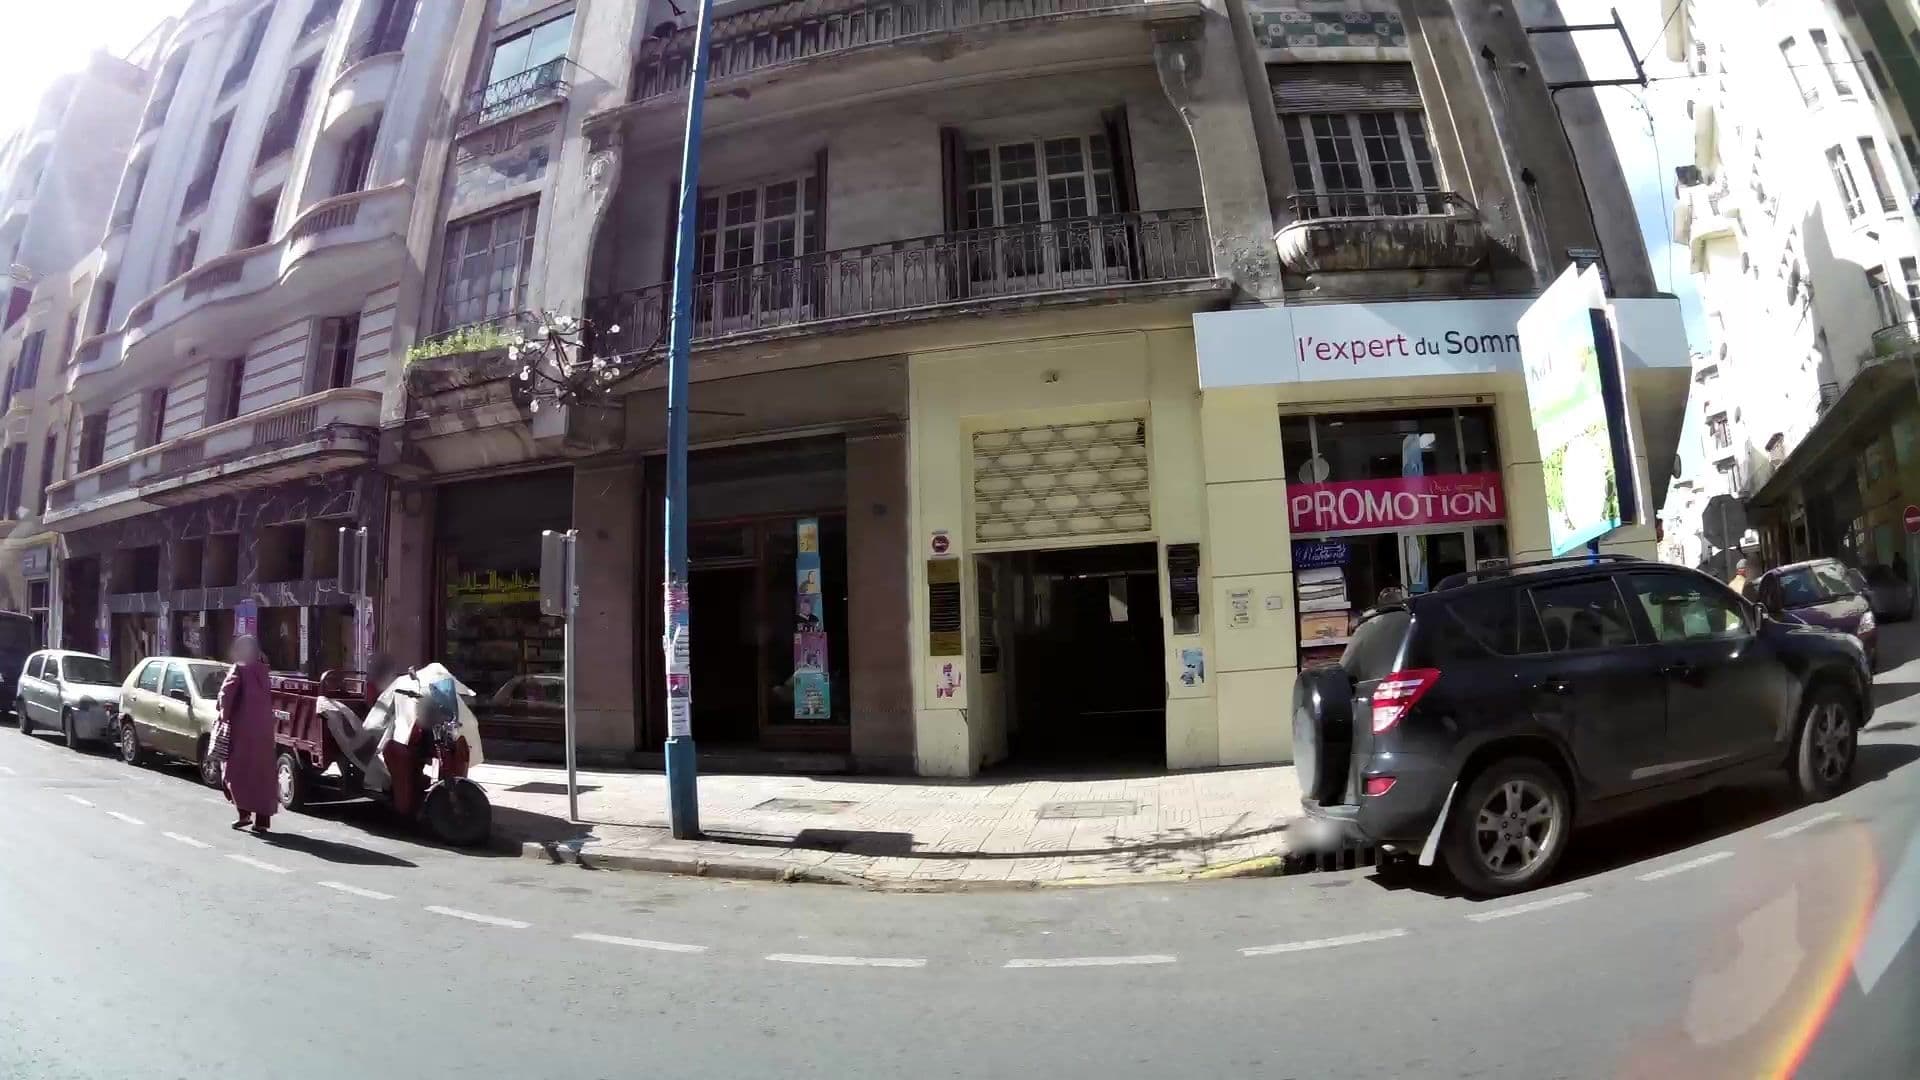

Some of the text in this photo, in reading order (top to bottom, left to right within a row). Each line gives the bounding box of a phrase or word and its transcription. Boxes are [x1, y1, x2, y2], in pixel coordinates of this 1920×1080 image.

[1298, 333, 1409, 364] l'expert
[1415, 337, 1440, 356] du
[1291, 486, 1497, 527] PROMOTION
